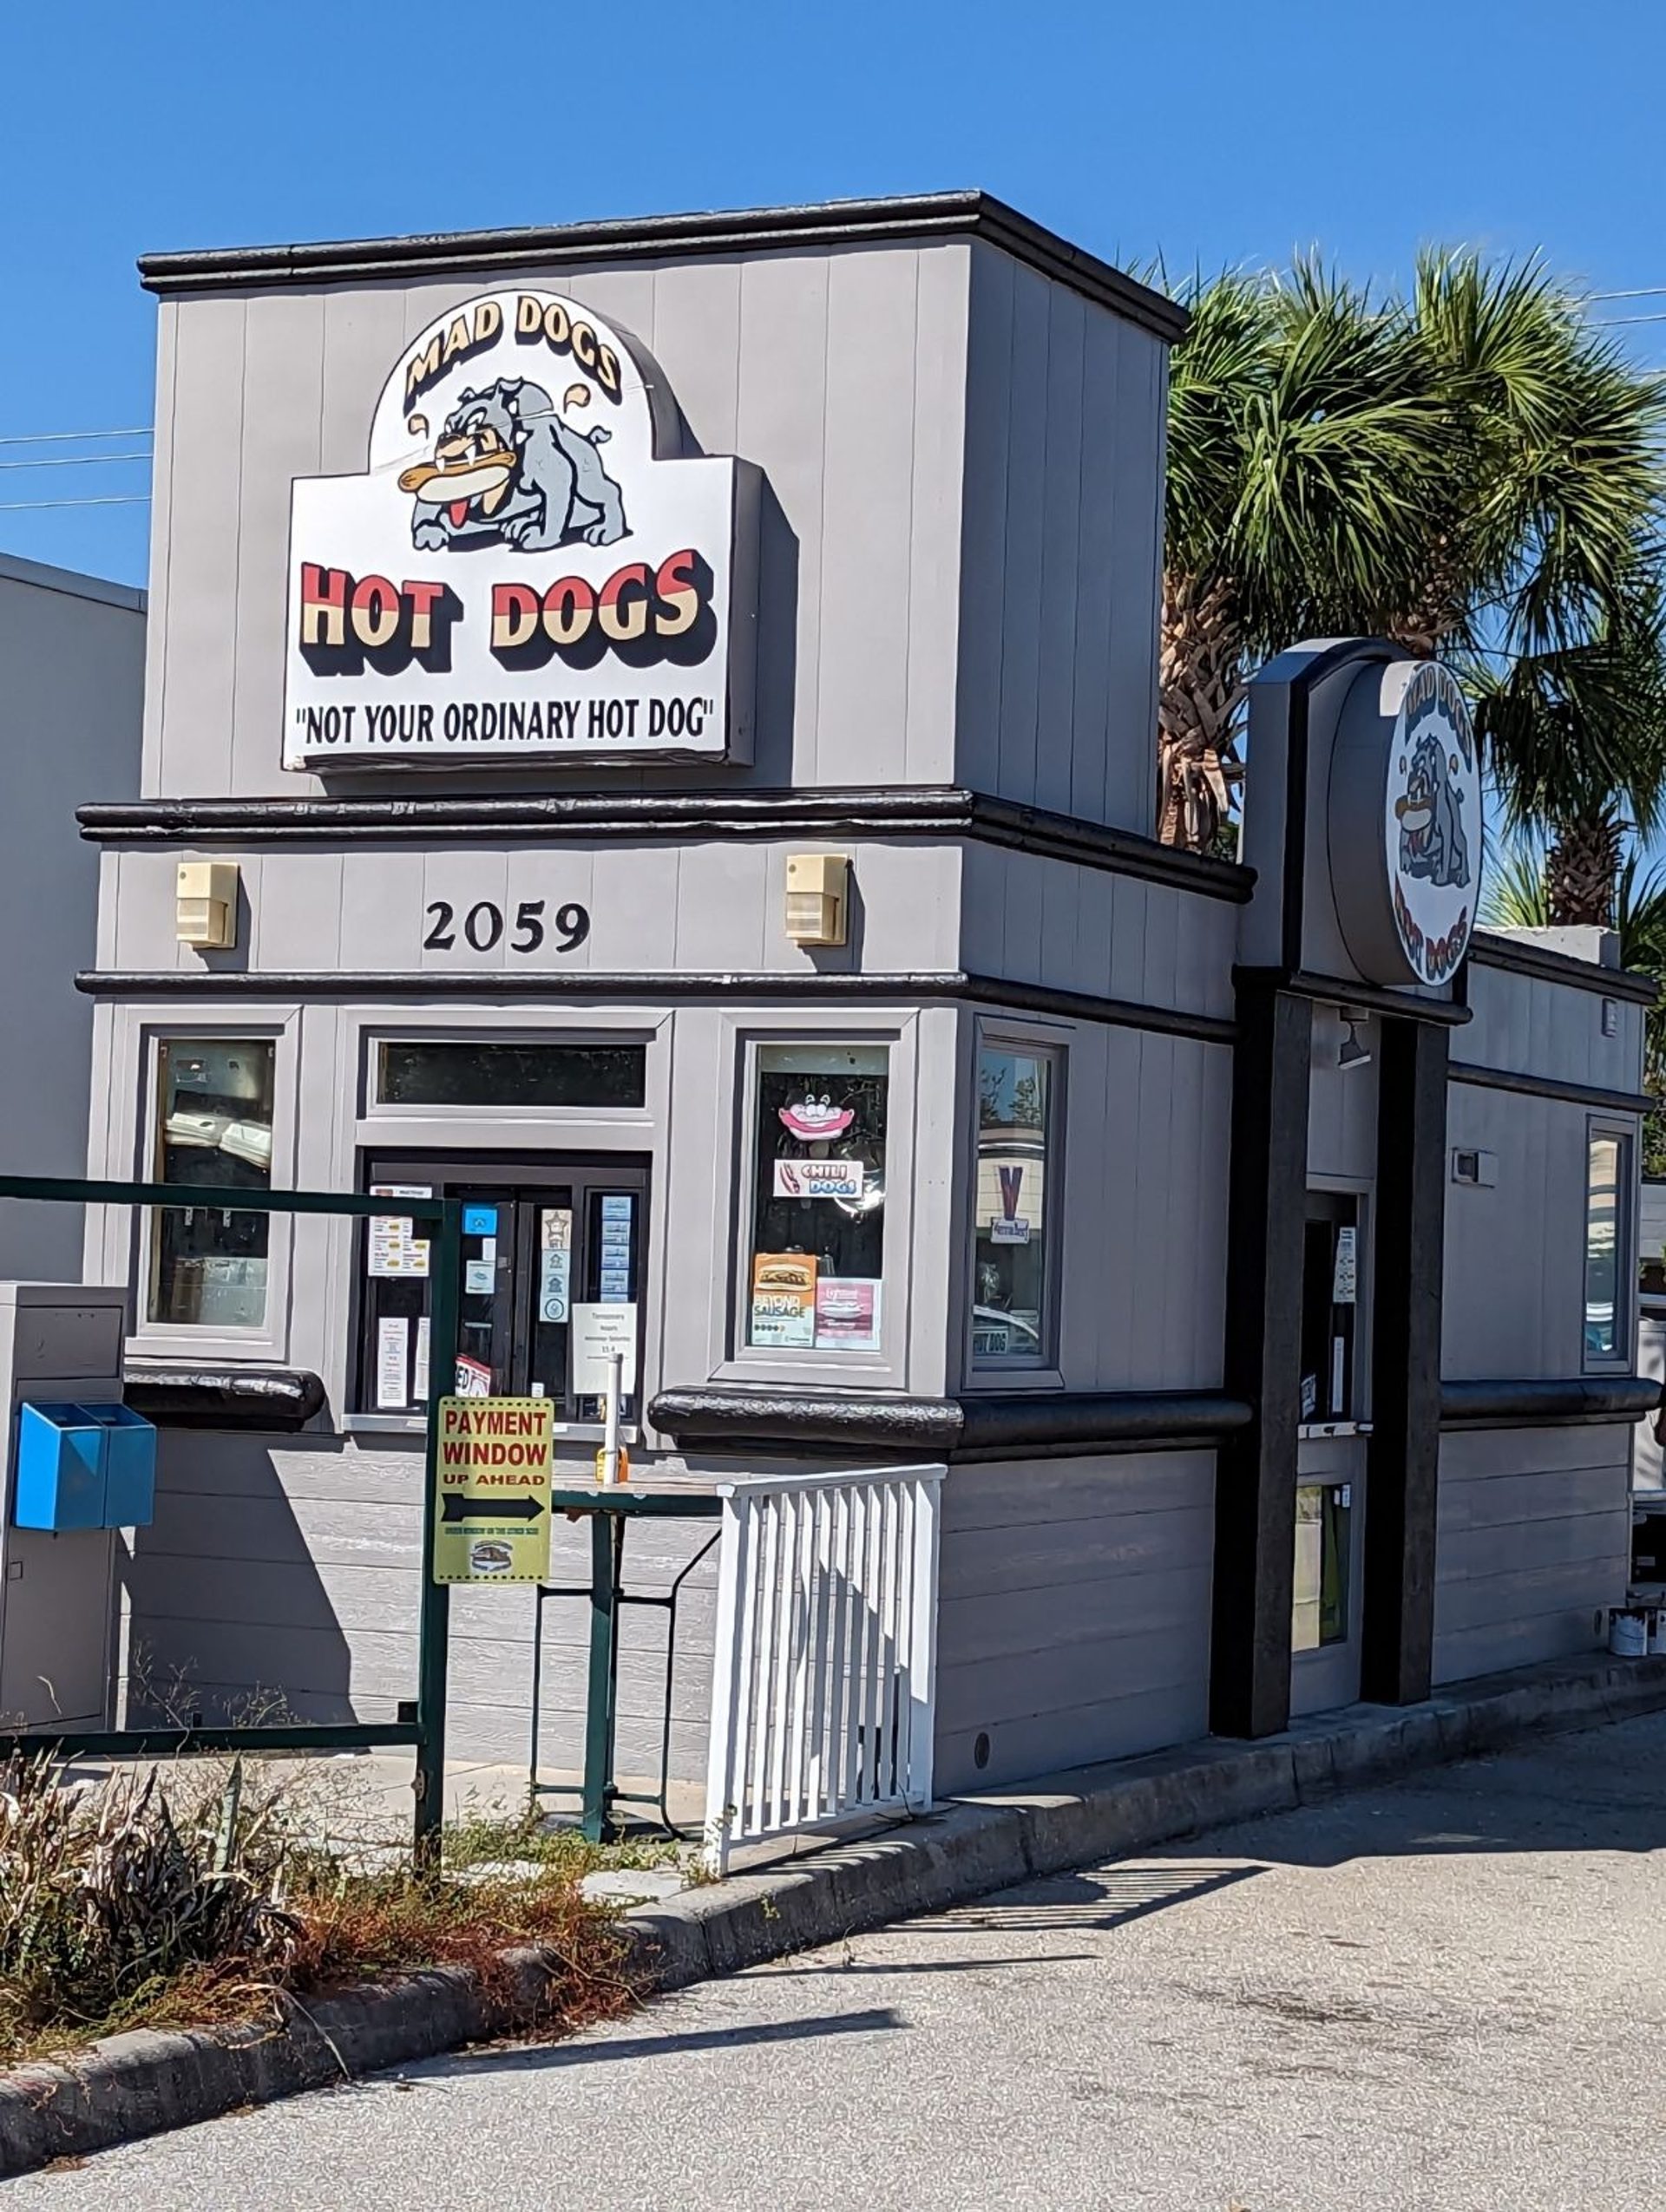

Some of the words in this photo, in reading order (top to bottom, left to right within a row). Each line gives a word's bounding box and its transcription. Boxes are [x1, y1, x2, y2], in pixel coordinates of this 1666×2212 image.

[404, 301, 503, 408] MAD
[515, 296, 621, 402] DOGS
[301, 562, 453, 666] HOT
[490, 550, 712, 666] DOGS
[296, 706, 356, 743] "NOT
[364, 704, 434, 742] YOUR
[443, 700, 580, 740] ORDINARY
[587, 699, 640, 738] HOT
[648, 697, 713, 737] DOG"
[423, 900, 590, 953] 2059
[801, 1164, 848, 1180] CHILI
[810, 1179, 856, 1194] DOGS
[754, 1305, 805, 1318] SAUSAGE
[445, 1410, 547, 1436] PAYMENT
[443, 1441, 548, 1466] WINDOW
[443, 1474, 469, 1484] UP
[476, 1475, 545, 1486] AHEAD
